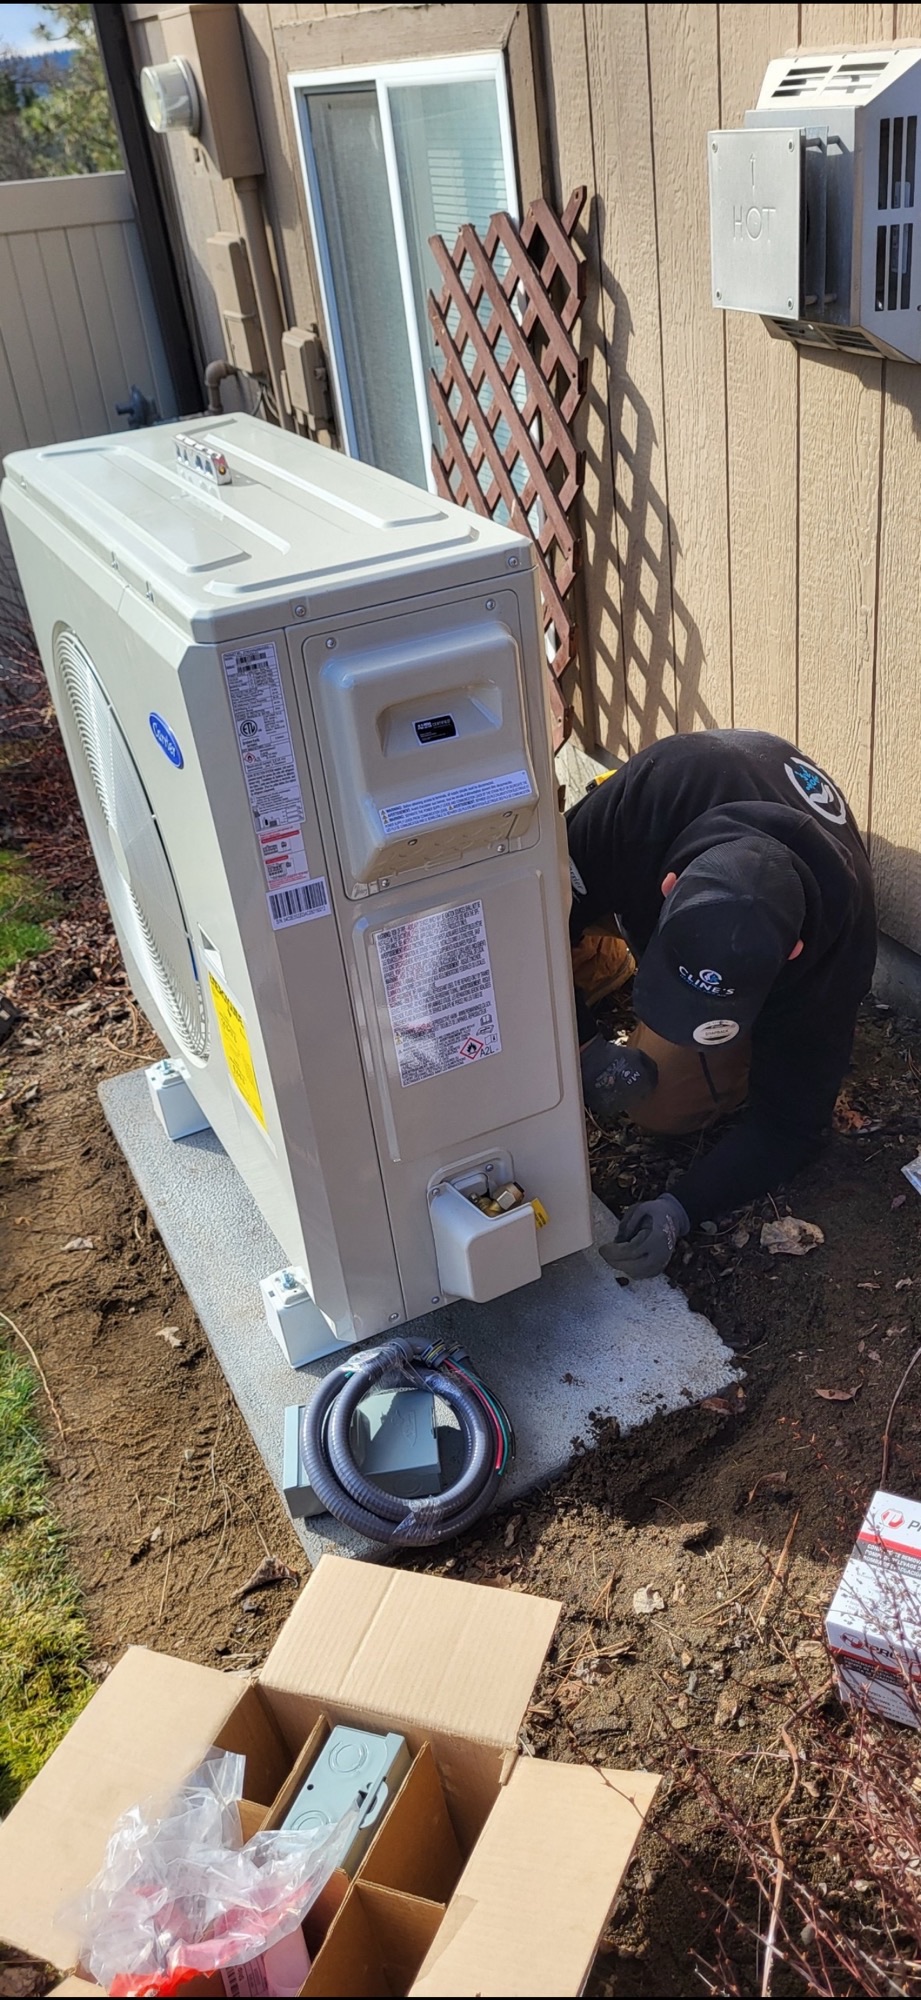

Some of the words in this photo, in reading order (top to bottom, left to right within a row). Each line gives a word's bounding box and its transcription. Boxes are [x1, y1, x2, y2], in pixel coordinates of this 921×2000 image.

[733, 205, 776, 243] HOT
[678, 965, 736, 995] CLINE'S
[480, 1046, 495, 1057] A2L
